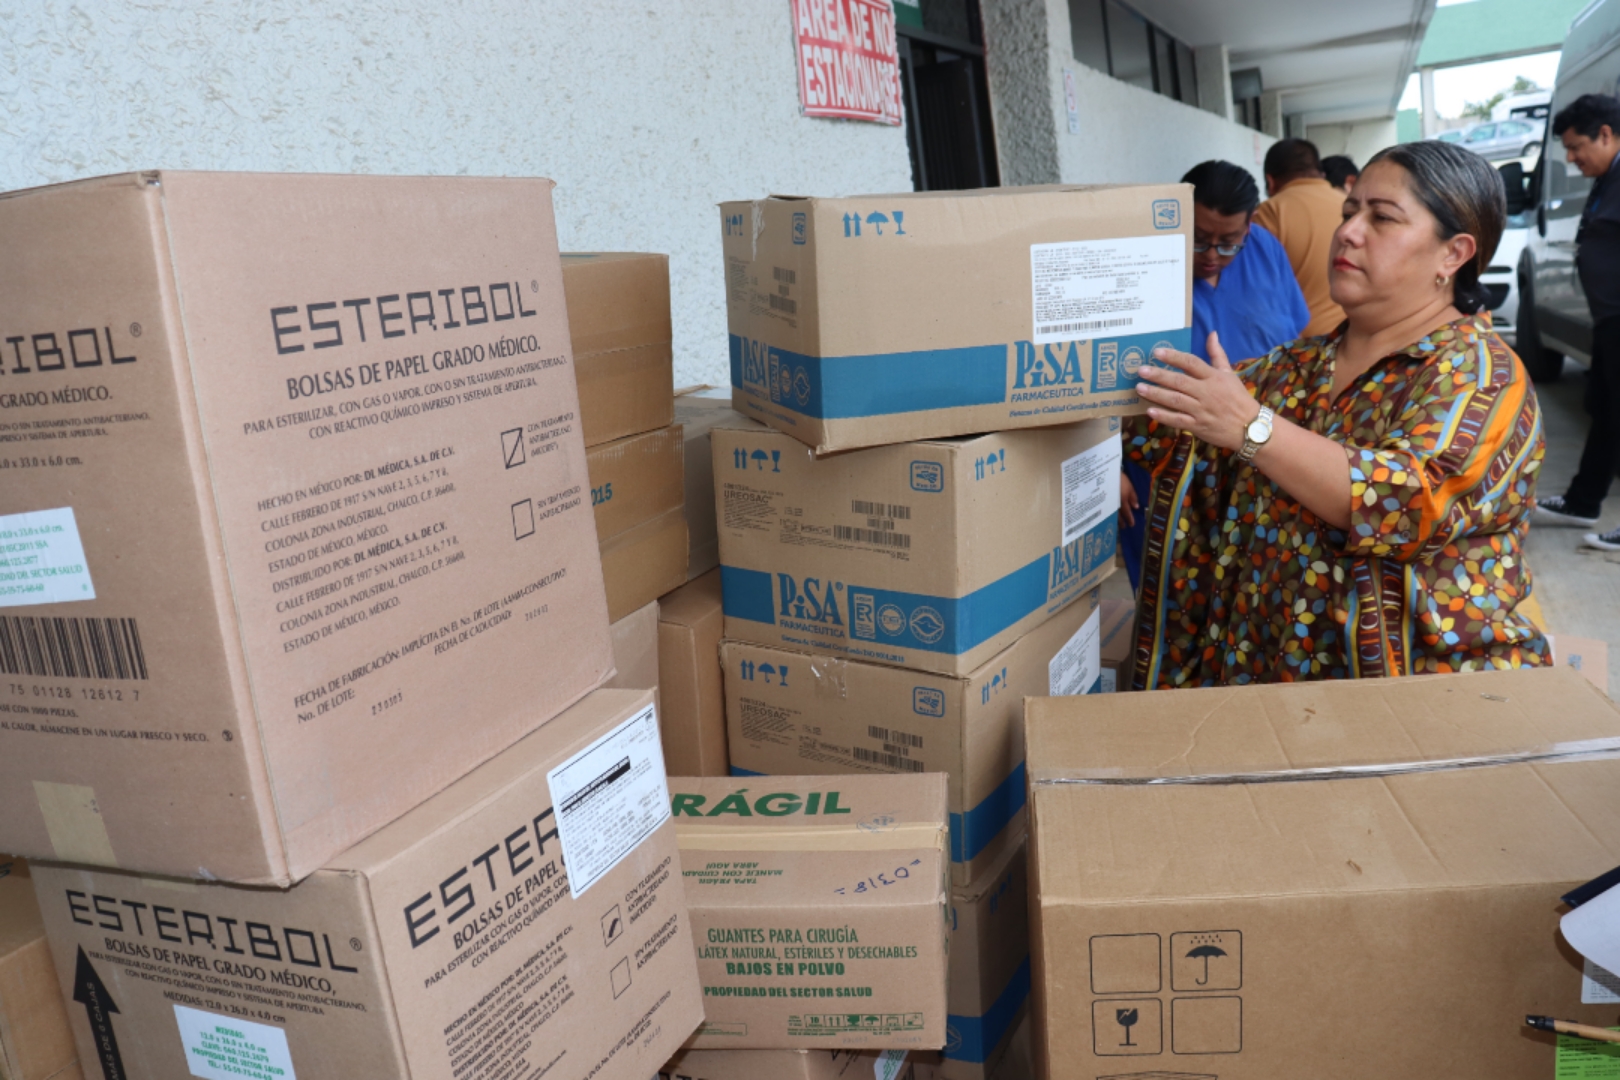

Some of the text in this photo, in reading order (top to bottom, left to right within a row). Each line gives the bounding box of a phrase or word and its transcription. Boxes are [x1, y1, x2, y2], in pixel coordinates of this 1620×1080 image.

[849, 0, 872, 51] DE
[871, 8, 893, 57] NO
[802, 45, 899, 116] ESTACIONARSE
[287, 335, 540, 399] BOLSAS DE PAPEL GRADO MÉDICO.
[1, 385, 113, 408] GRADO MÉDICO.
[243, 418, 274, 434] PARA
[339, 401, 361, 414] CON
[362, 395, 381, 408] GAS
[382, 393, 391, 404] O
[424, 383, 442, 395] CON
[443, 380, 451, 390] O
[452, 378, 465, 389] SIN
[1011, 387, 1083, 402] FARMACEUTICA
[308, 425, 332, 439] CON
[334, 413, 378, 433] REACTIVO
[380, 403, 420, 423] QUÍMICO
[456, 394, 461, 404] Y
[463, 388, 492, 402] SISTEMA
[493, 385, 502, 394] DE
[257, 493, 293, 511] HECHO
[295, 490, 307, 501] EN
[309, 479, 342, 495] MÉXICO
[430, 450, 439, 461] DE
[268, 553, 305, 573] ESTADO
[307, 547, 319, 560] DE
[272, 564, 331, 593] DISTRIBUIDO
[421, 526, 431, 538] DE
[780, 620, 845, 638] FARMACEUTICA
[9, 684, 25, 695] 75
[33, 685, 71, 698] 01128
[133, 690, 139, 701] 7
[294, 686, 327, 707] FECHA
[328, 678, 340, 692] DE
[317, 700, 329, 715] DE
[670, 789, 851, 817] RÁGIL
[453, 860, 558, 949] BOLSAS DE PAPEL
[424, 968, 447, 988] PARA
[490, 921, 507, 938] CON
[508, 908, 522, 924] GAS
[708, 925, 858, 943] GUANTES PARA CIRUGÍA
[104, 937, 150, 958] BOLSAS
[152, 947, 170, 962] DE
[173, 951, 210, 970] PAPEL
[213, 959, 266, 981] GRADO
[471, 950, 489, 968] CON
[699, 945, 917, 960] LÁTEX NATURAL, ESTÉRILES Y DESECHABLES
[726, 963, 844, 975] BAJOS EN POLVO
[704, 987, 872, 998] PROPIEDAD DEL SECTOR SALUD
